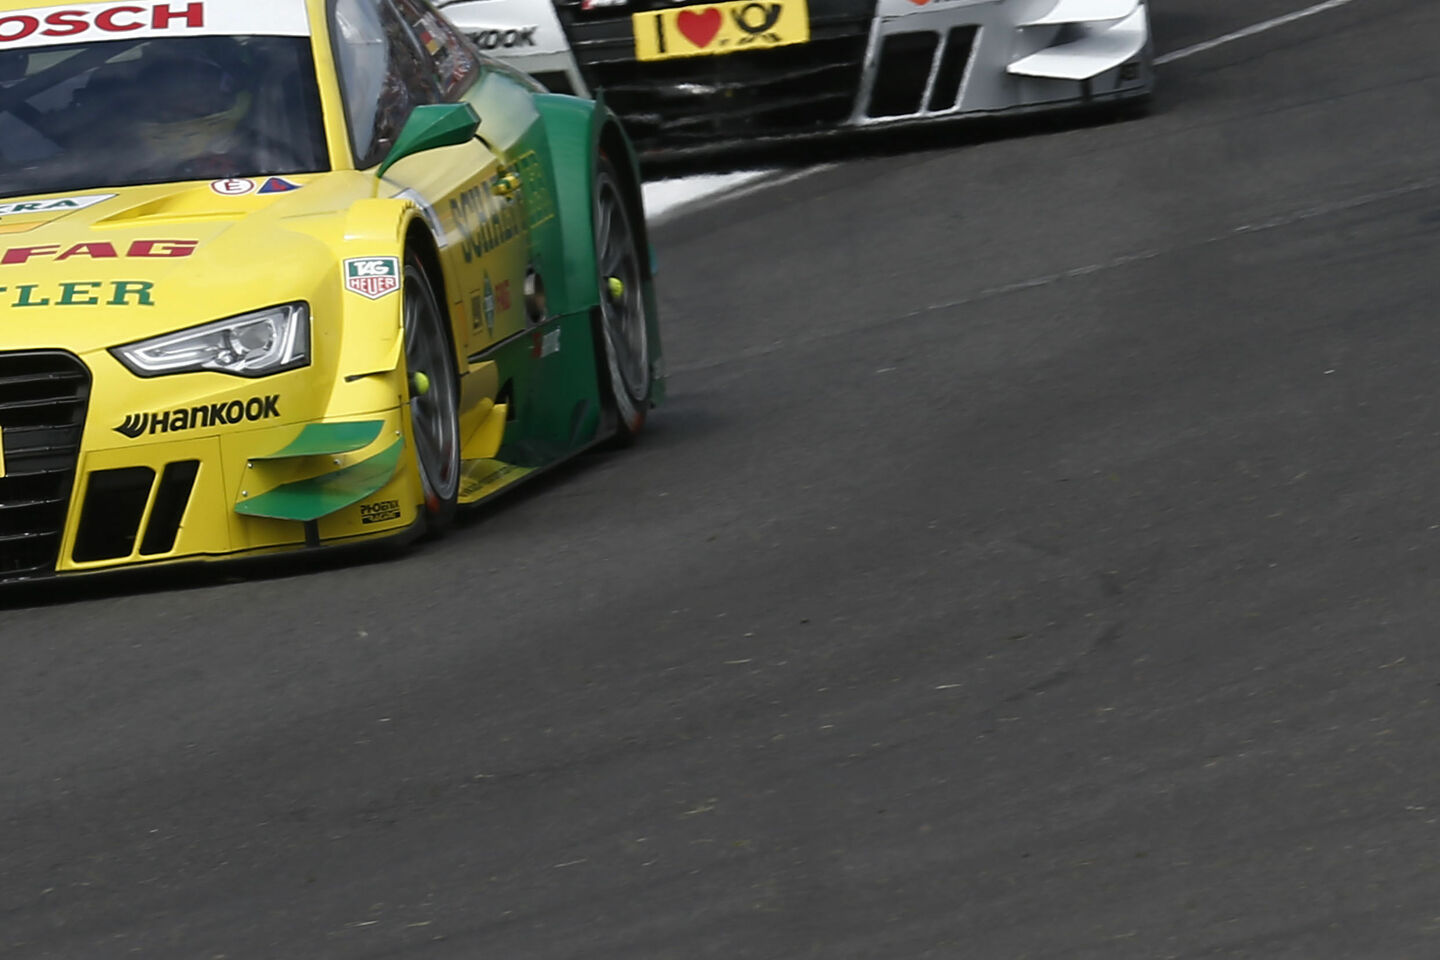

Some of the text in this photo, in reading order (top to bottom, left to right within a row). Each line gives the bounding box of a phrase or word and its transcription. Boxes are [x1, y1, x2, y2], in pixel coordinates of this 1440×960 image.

[0, 239, 199, 266] FAG
[352, 260, 390, 276] TAG
[350, 277, 396, 295] HEUER
